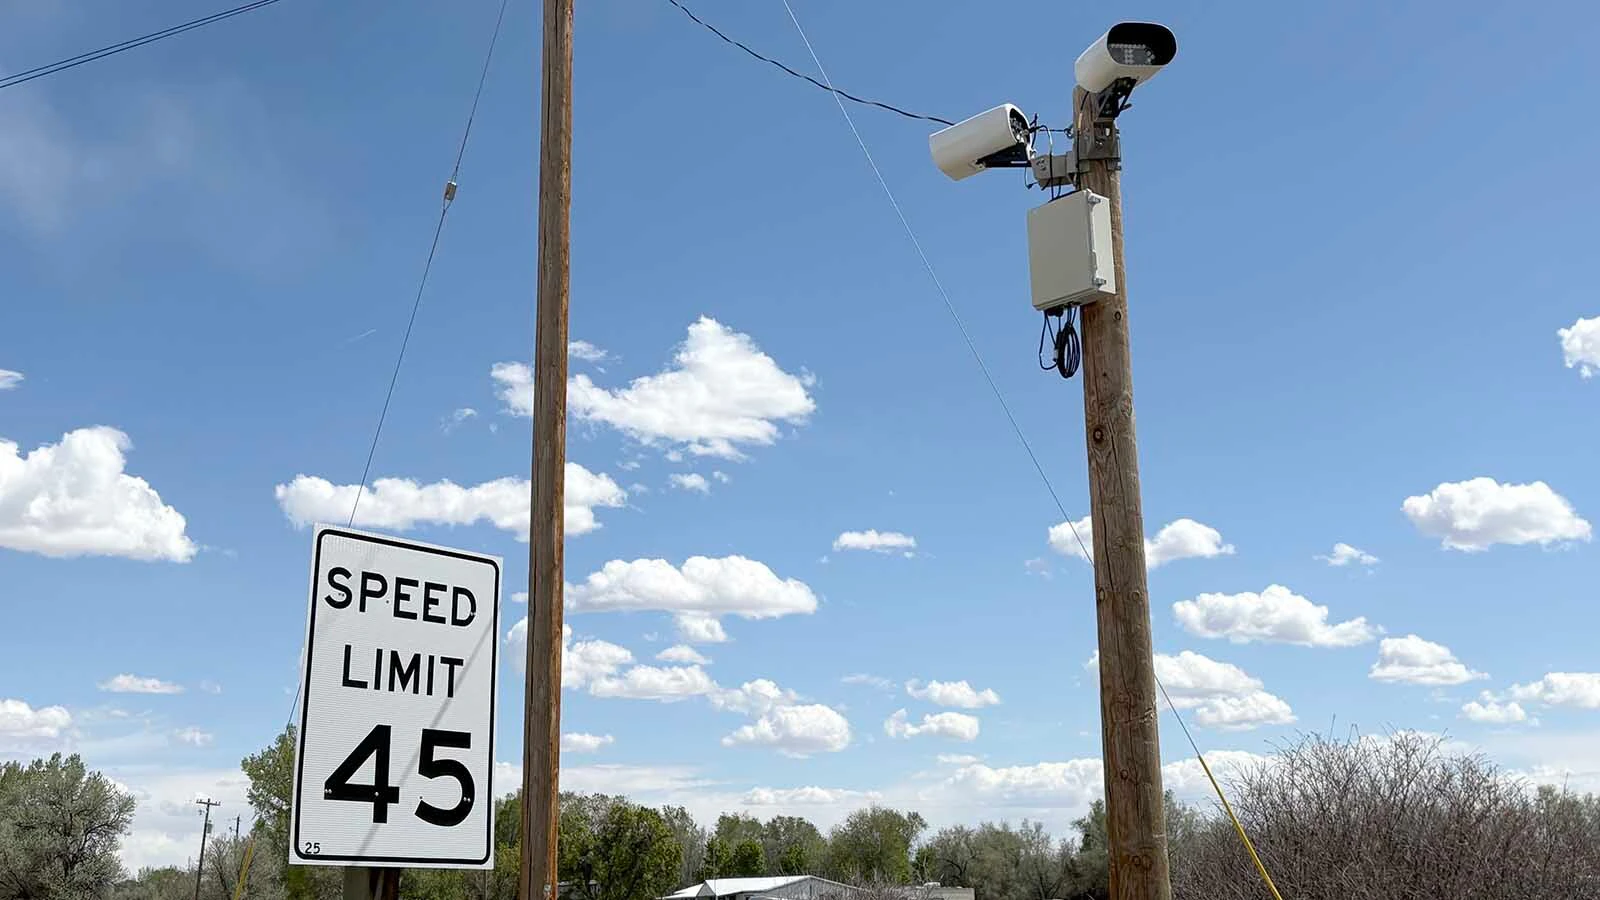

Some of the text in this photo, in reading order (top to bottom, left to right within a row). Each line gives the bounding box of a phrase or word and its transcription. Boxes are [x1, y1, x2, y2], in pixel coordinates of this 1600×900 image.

[324, 566, 477, 627] SPEED
[343, 644, 464, 697] LIMIT
[323, 724, 476, 827] 45
[305, 842, 320, 854] 25
